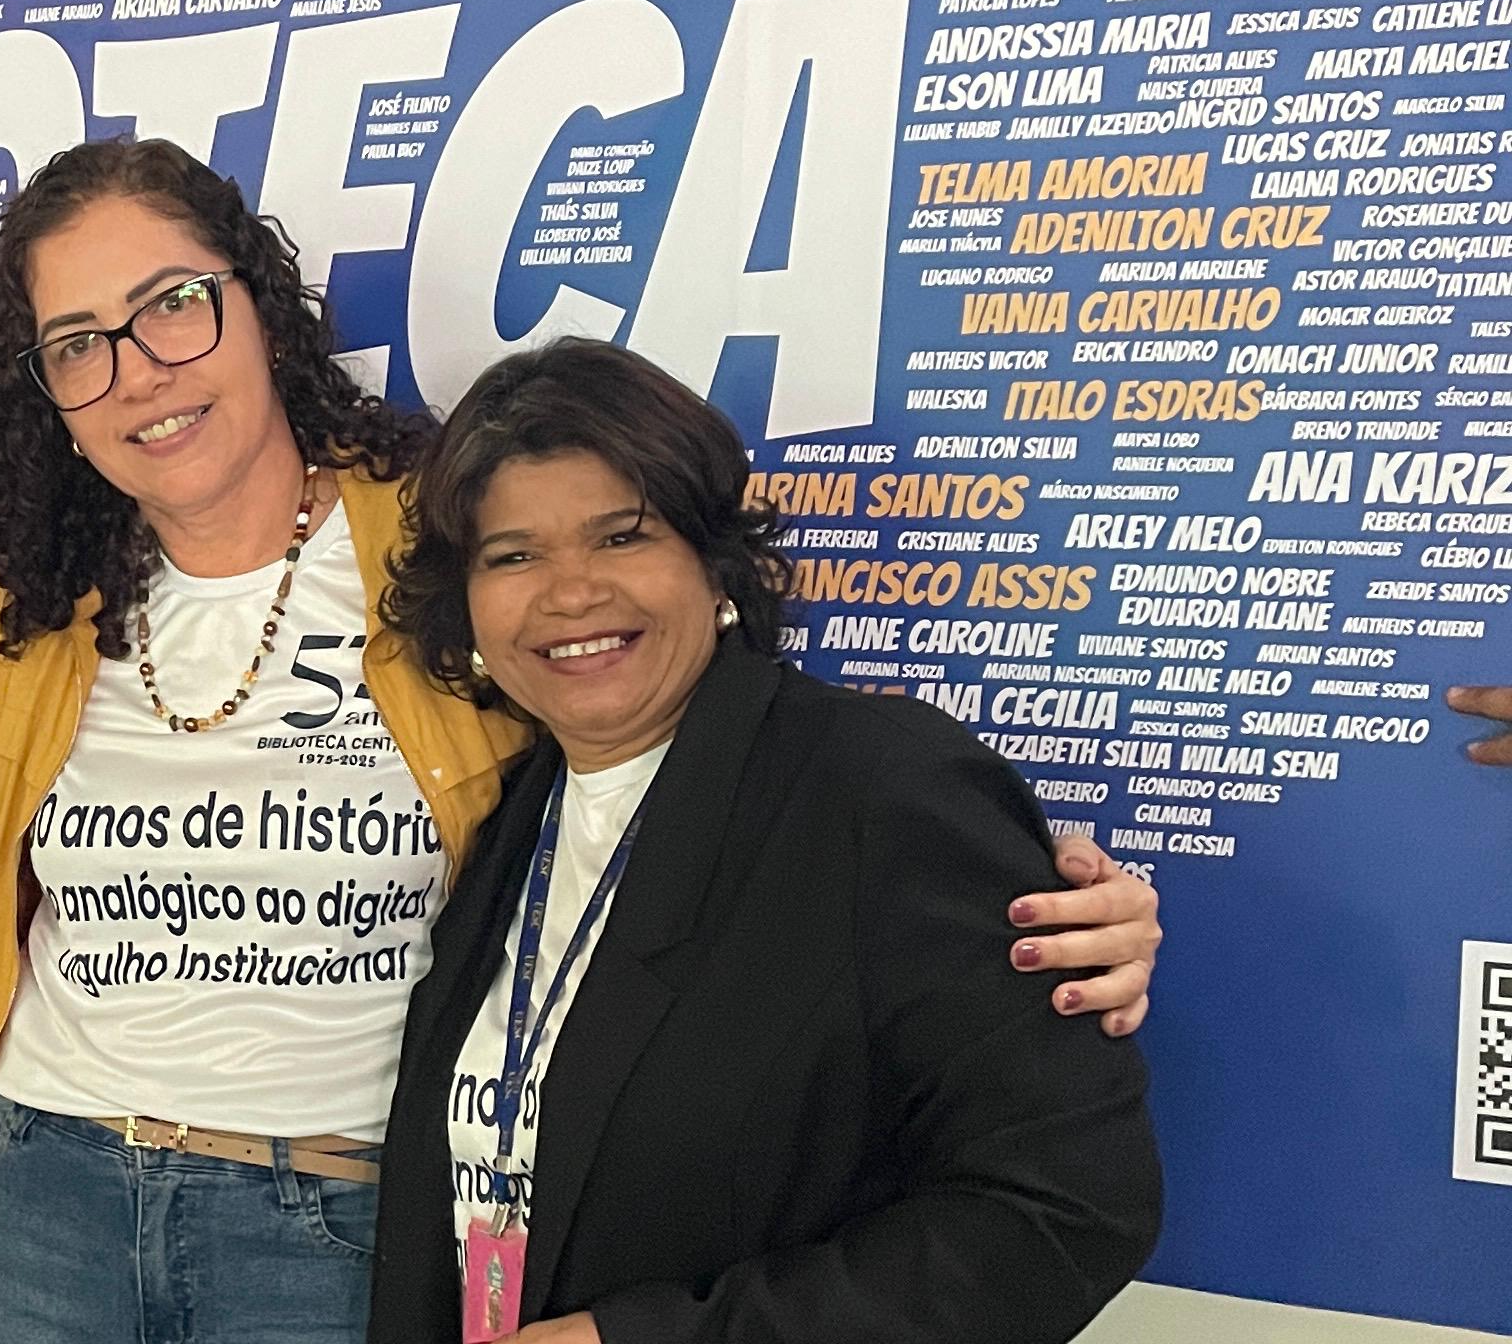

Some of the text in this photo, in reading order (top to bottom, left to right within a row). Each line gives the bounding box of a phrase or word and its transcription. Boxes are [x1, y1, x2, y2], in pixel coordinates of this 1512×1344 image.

[925, 12, 1211, 64] ANDRISSIA MARIA
[1305, 40, 1511, 80] MARTA MACIEL
[368, 92, 451, 117] JOSÉ FILINTO
[914, 66, 1103, 112] ELSON LIMA
[1175, 91, 1383, 132] INGRID SANTOS
[917, 152, 1209, 206] TELMA AMORIM
[1009, 204, 1332, 256] ADENILTON CRUZ
[960, 286, 1281, 336] VANIA CARVALHO
[1336, 343, 1438, 374] JUNIOR
[1003, 379, 1267, 422] ITALO ESDRAS
[866, 473, 1030, 520] SANTOS
[1248, 450, 1353, 503] ANA
[1064, 514, 1262, 552] ARLEY MELO
[967, 563, 1097, 612] ASSIS
[1110, 564, 1334, 597] EDMUNDO NOBRE
[820, 616, 1058, 658] ANNE CAROLINE
[991, 687, 1118, 730] CECILIA
[257, 736, 347, 752] BIBLIOTECA
[298, 754, 377, 769] 1975-2025
[1103, 740, 1172, 769] SILVA
[1180, 745, 1339, 779] WILMA SENA
[1128, 777, 1282, 803] LEONARDO GOMES
[60, 804, 171, 849] anos
[182, 791, 244, 849] de
[1135, 804, 1211, 826] GILMARA
[1111, 829, 1235, 856] VANIA CASSIA
[63, 870, 245, 936] analógico
[257, 887, 306, 926] ao
[317, 878, 435, 937] digital
[175, 942, 411, 986] Institucional
